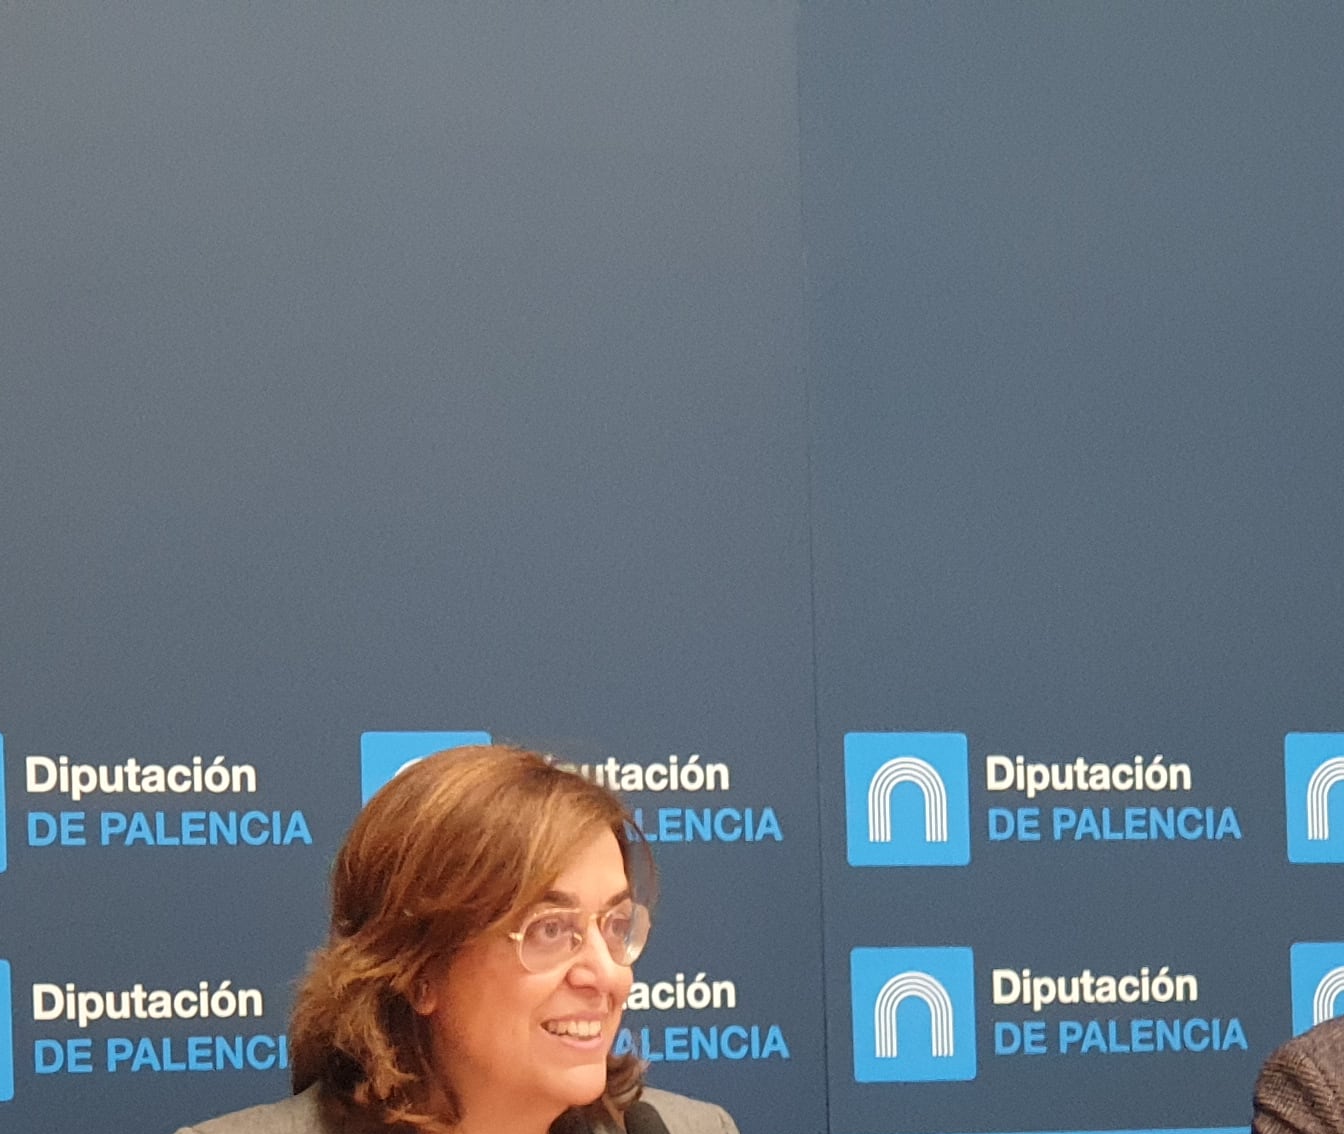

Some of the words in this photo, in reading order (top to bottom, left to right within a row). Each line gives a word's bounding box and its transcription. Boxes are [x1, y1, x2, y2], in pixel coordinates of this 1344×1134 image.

[25, 755, 257, 800] Diputación
[580, 754, 730, 792] utación
[986, 754, 1192, 798] Diputación
[28, 811, 87, 848] DE
[99, 810, 314, 847] PALENCIA
[628, 806, 784, 844] LENCIA
[988, 807, 1042, 842] DE
[1052, 806, 1243, 842] PALENCIA
[32, 980, 263, 1028] Diputación
[625, 972, 736, 1011] ación
[992, 966, 1198, 1012] Diputación
[34, 1037, 93, 1074] DE
[106, 1034, 287, 1073] PALENCI
[614, 1024, 791, 1062] ALENCIA
[994, 1020, 1049, 1056] DE
[1058, 1017, 1249, 1055] PALENCIA
